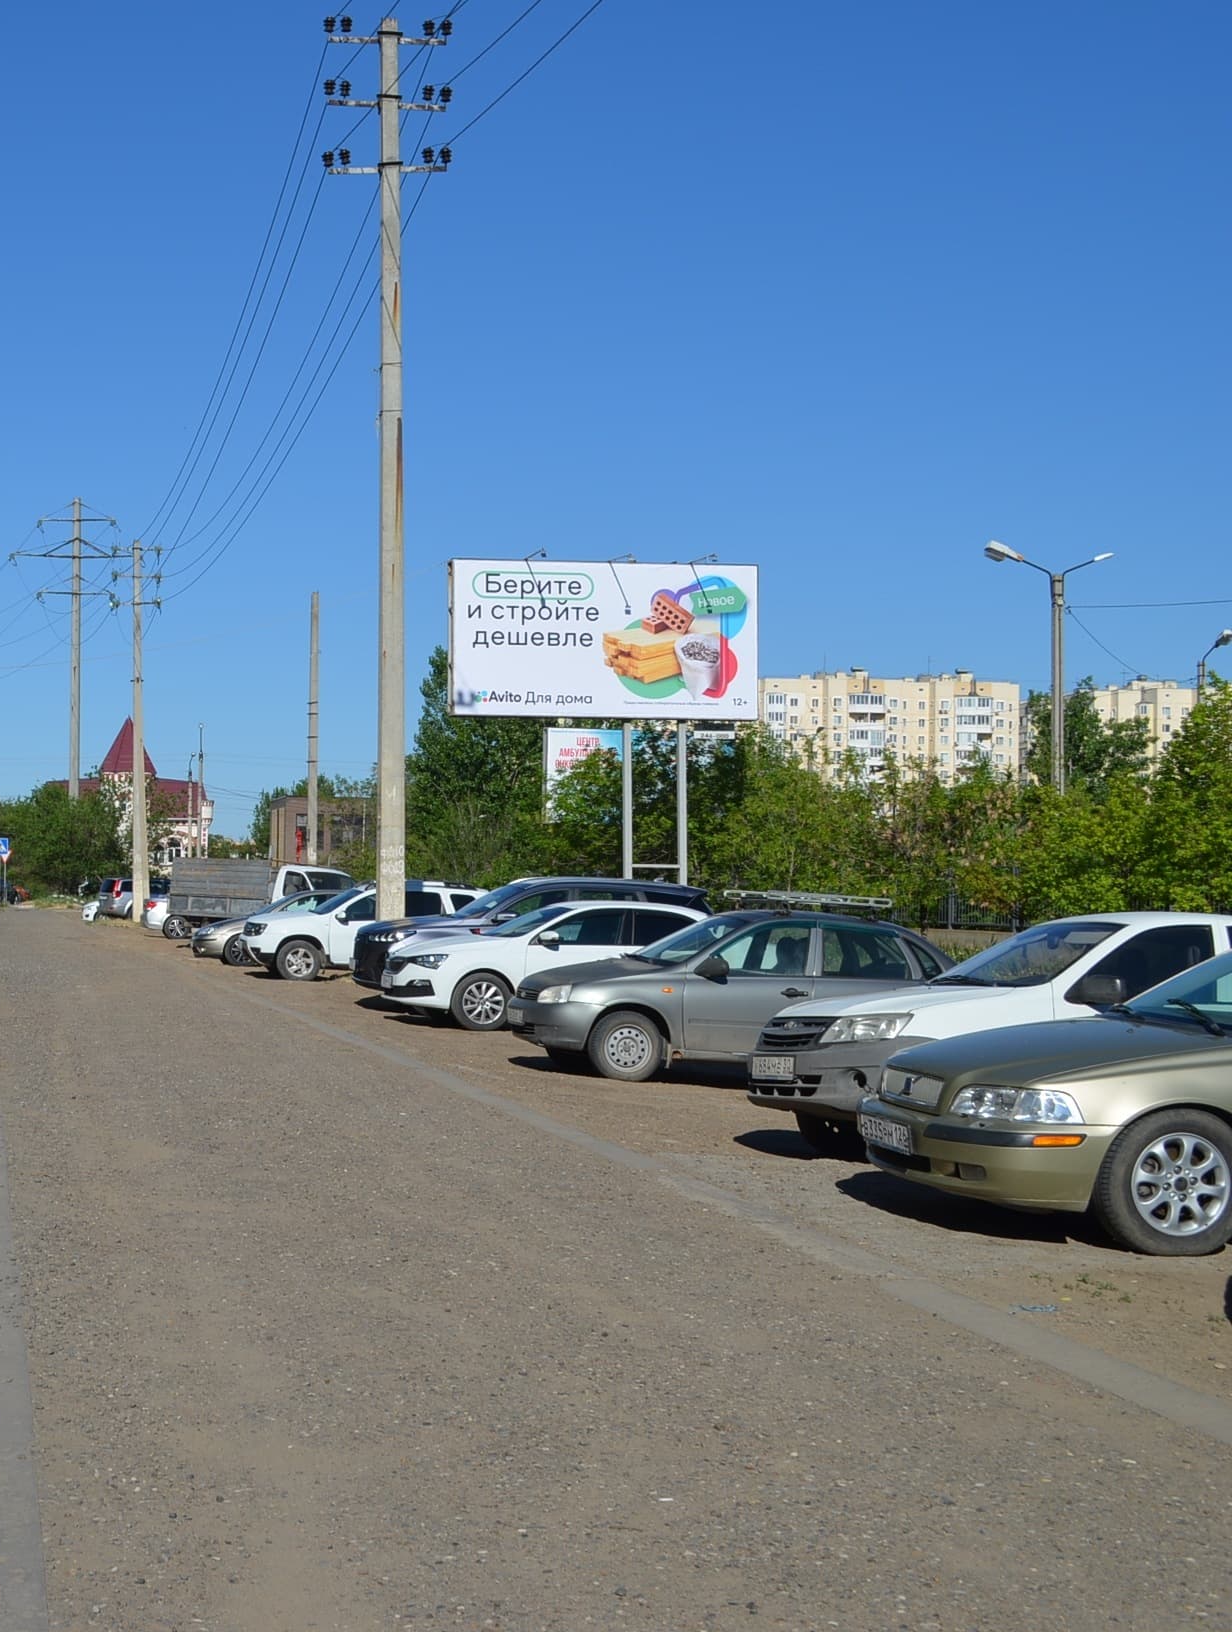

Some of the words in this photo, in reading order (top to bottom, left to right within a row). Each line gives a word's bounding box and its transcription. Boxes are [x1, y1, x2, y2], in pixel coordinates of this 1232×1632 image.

[485, 573, 582, 600] Берите
[467, 604, 482, 619] и
[491, 600, 600, 626] стройте
[472, 630, 594, 649] дешевле
[488, 690, 522, 703] Avito
[524, 691, 552, 706] Для
[555, 694, 593, 706] дома
[733, 697, 748, 706] 12+
